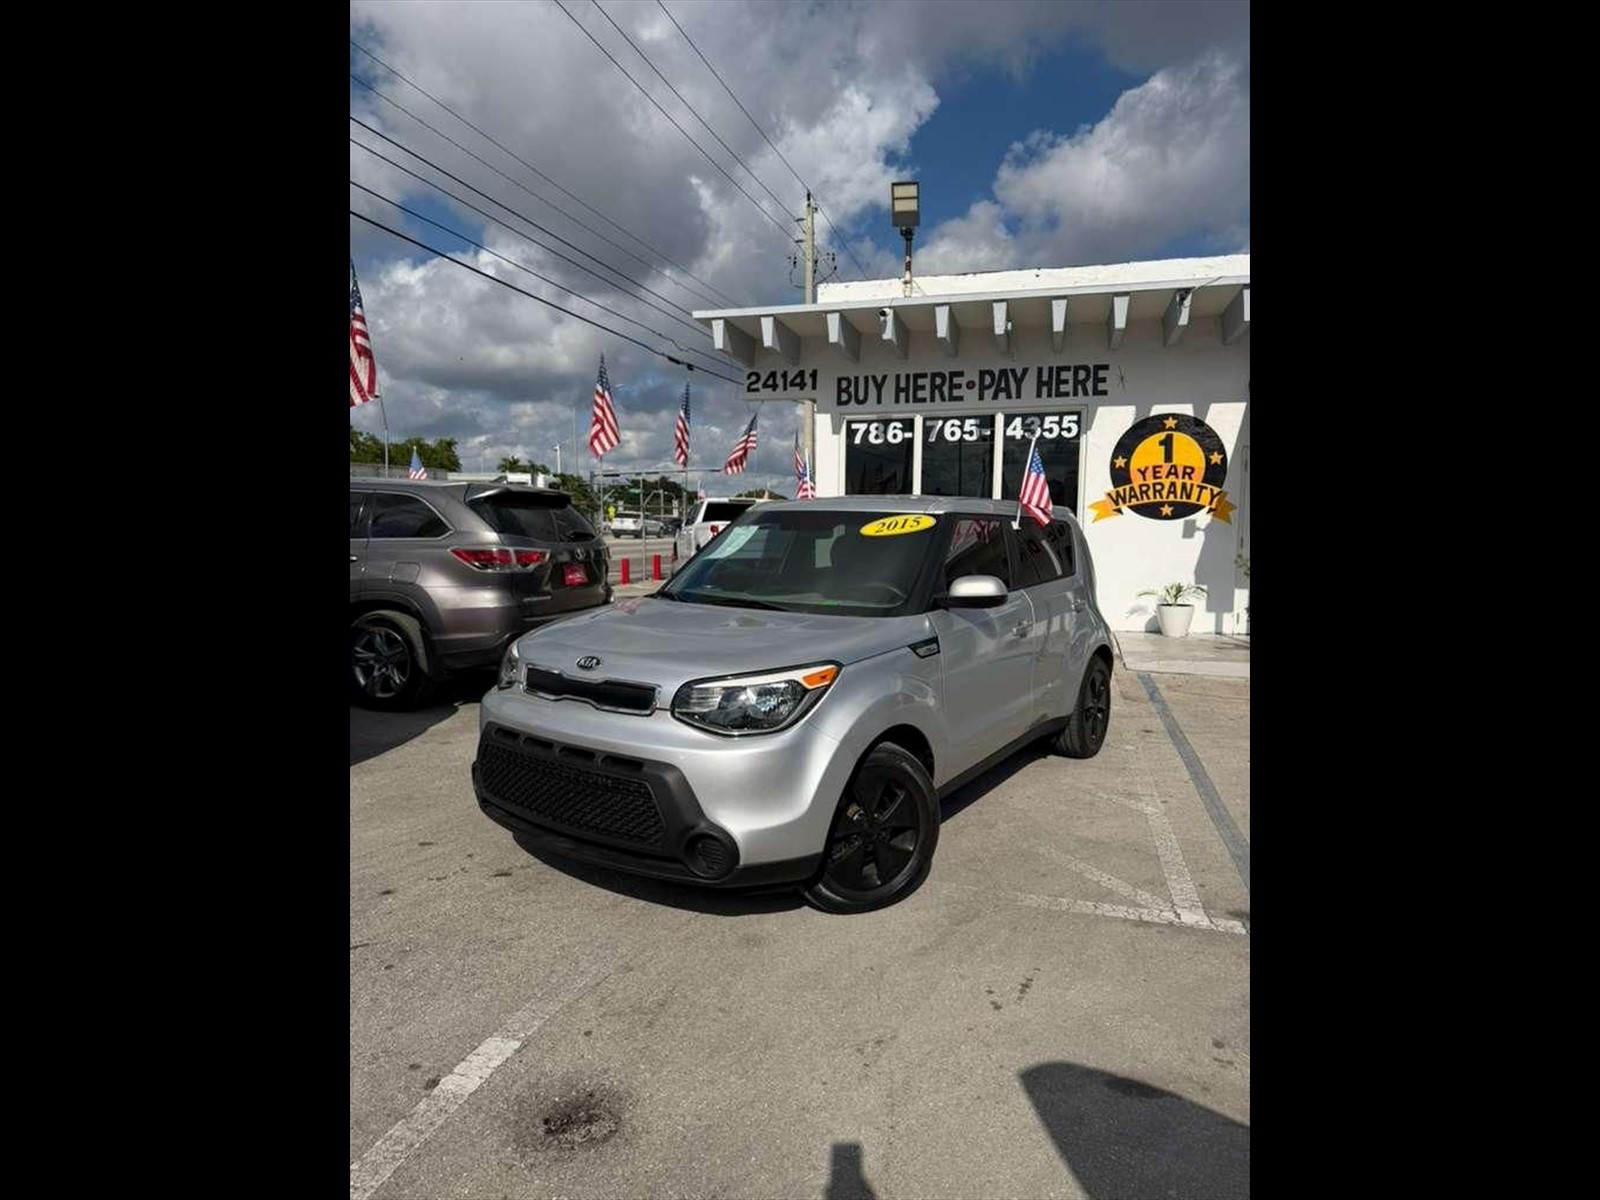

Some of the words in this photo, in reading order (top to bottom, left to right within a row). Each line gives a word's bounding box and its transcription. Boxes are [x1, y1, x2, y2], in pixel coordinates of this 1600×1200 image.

[747, 369, 817, 392] 24141
[836, 374, 887, 406] BUY
[894, 371, 965, 403] HERE
[978, 366, 1029, 401] PAY
[1036, 364, 1110, 398] HERE
[851, 421, 913, 444] 786-
[1005, 414, 1079, 440] 4355
[1158, 433, 1174, 463] 1
[1137, 464, 1195, 482] YEAR
[1107, 482, 1223, 507] WARRANTY
[875, 517, 922, 533] 2015
